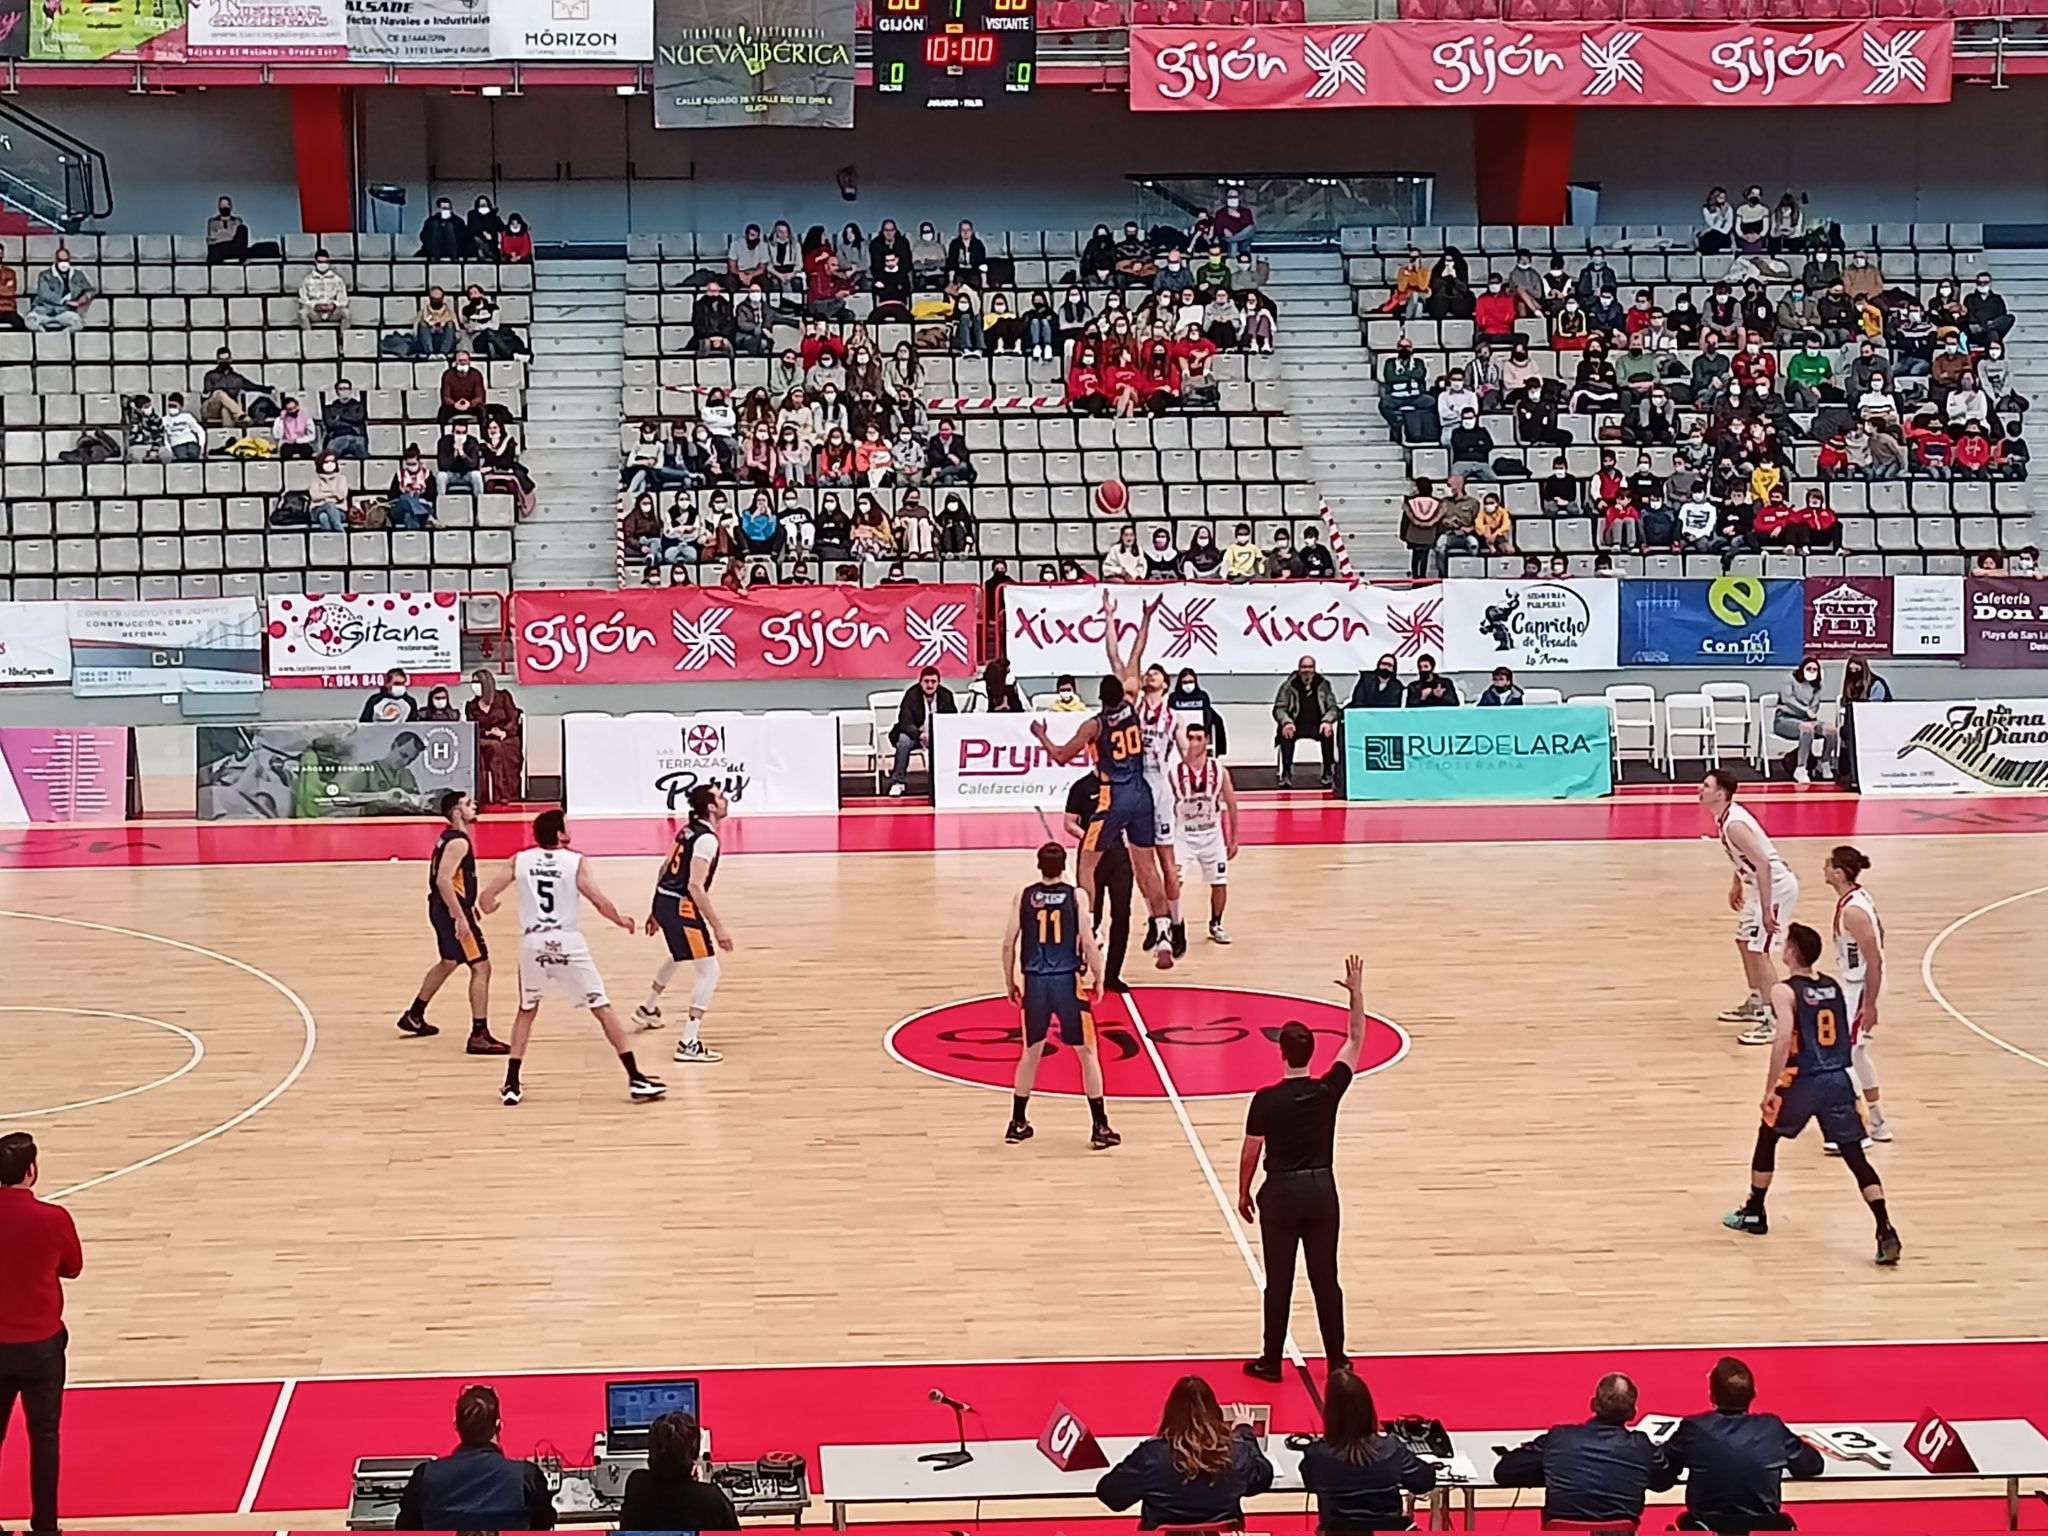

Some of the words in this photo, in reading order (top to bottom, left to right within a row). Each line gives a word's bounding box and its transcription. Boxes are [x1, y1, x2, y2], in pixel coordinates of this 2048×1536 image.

[380, 16, 420, 26] Navales
[433, 14, 490, 26] Industriales
[879, 16, 924, 32] GIJÓN
[985, 17, 1030, 31] VISITANTE
[926, 37, 993, 62] 10:00
[890, 63, 904, 83] 0
[1017, 63, 1031, 83] 0
[1156, 37, 1287, 101] gijón
[1432, 33, 1567, 95] gijón
[1711, 33, 1846, 96] gijón
[1244, 600, 1370, 648] Xixón
[1973, 605, 2036, 620] Don
[338, 616, 439, 643] Gitana
[1511, 611, 1586, 640] Capricho
[524, 609, 657, 674] gijón
[760, 608, 890, 667] gijón
[152, 651, 184, 666] CJ
[1946, 705, 2046, 732] Taberna
[433, 742, 449, 760] H
[1111, 724, 1142, 761] 30
[658, 757, 728, 769] TERRAZAS
[537, 879, 555, 914] 5
[1036, 909, 1062, 944] 11
[1817, 1008, 1837, 1047] 8
[1830, 1430, 1878, 1449] 3
